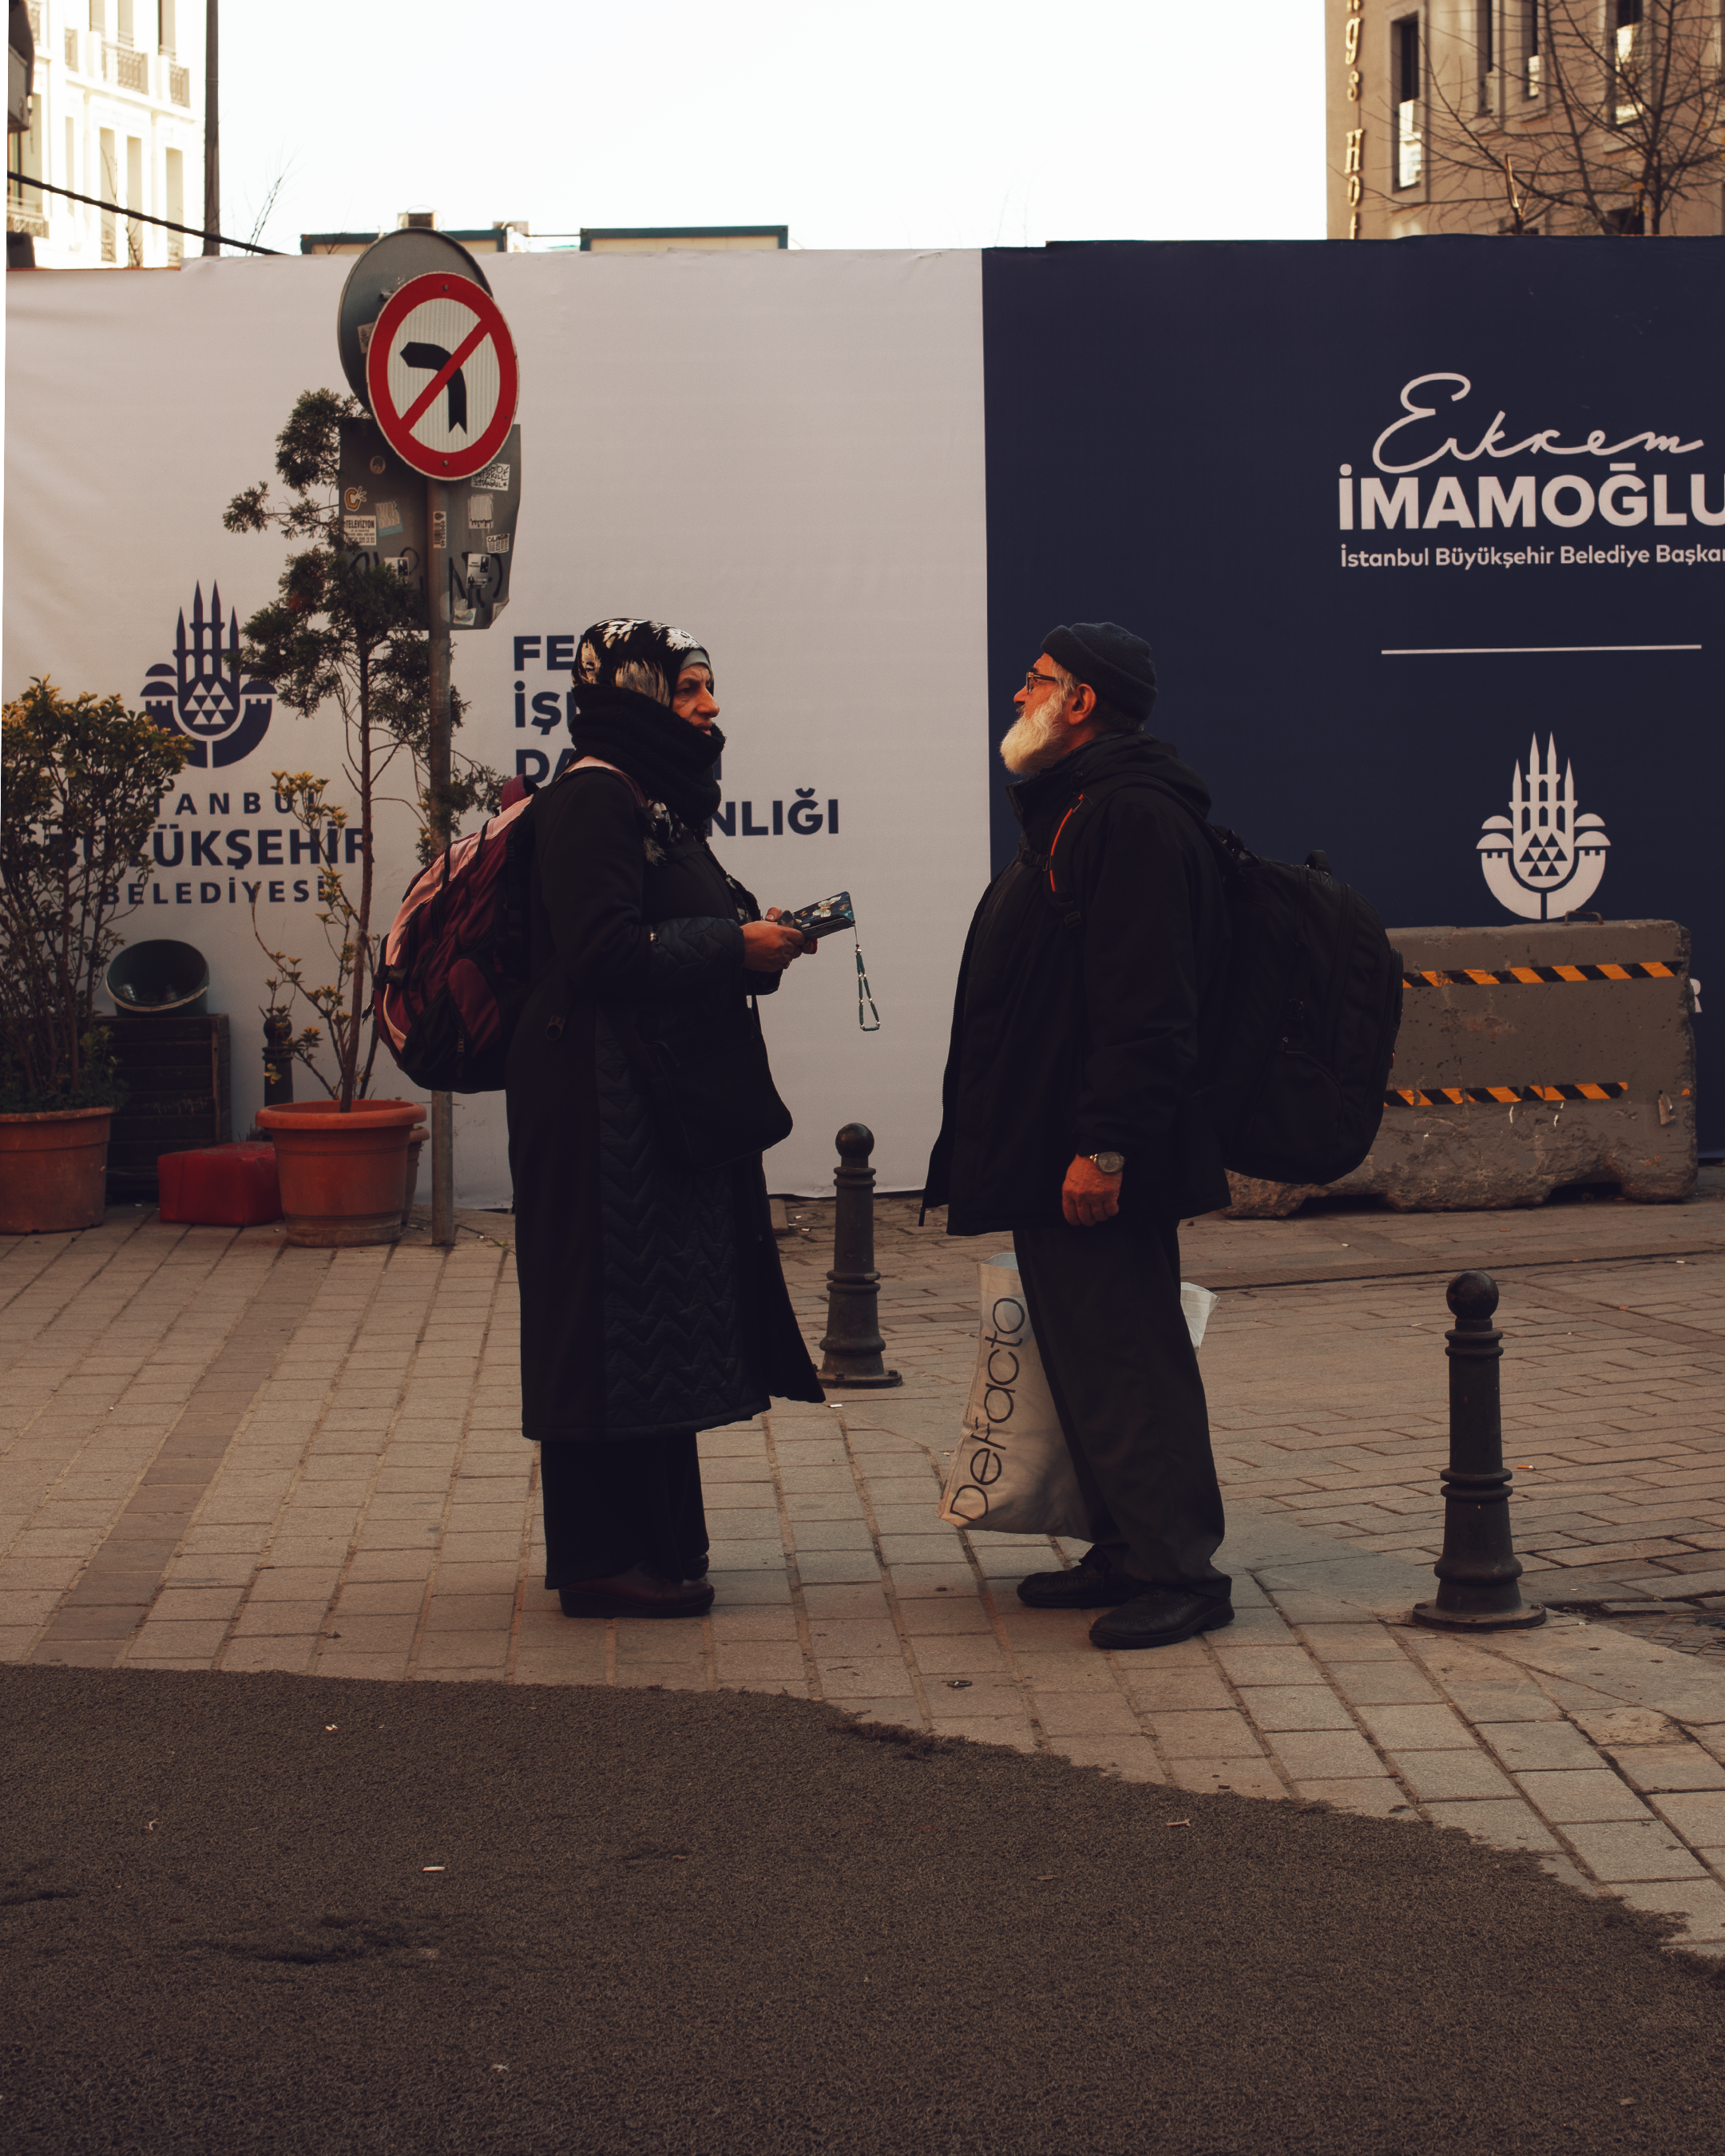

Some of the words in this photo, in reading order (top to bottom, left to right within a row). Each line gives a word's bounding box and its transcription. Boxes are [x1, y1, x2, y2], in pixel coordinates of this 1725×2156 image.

[1372, 372, 1704, 474] Ekrem
[1338, 462, 1725, 530] İMAMOĞLU
[346, 517, 375, 529] TELEVİZYON
[1341, 544, 1429, 568] İstanbul
[1436, 546, 1555, 570] Büyükşehir
[1560, 545, 1650, 568] Belediye
[1656, 544, 1725, 566] Başka
[514, 635, 582, 672] FE
[708, 787, 839, 838] NLIĞI
